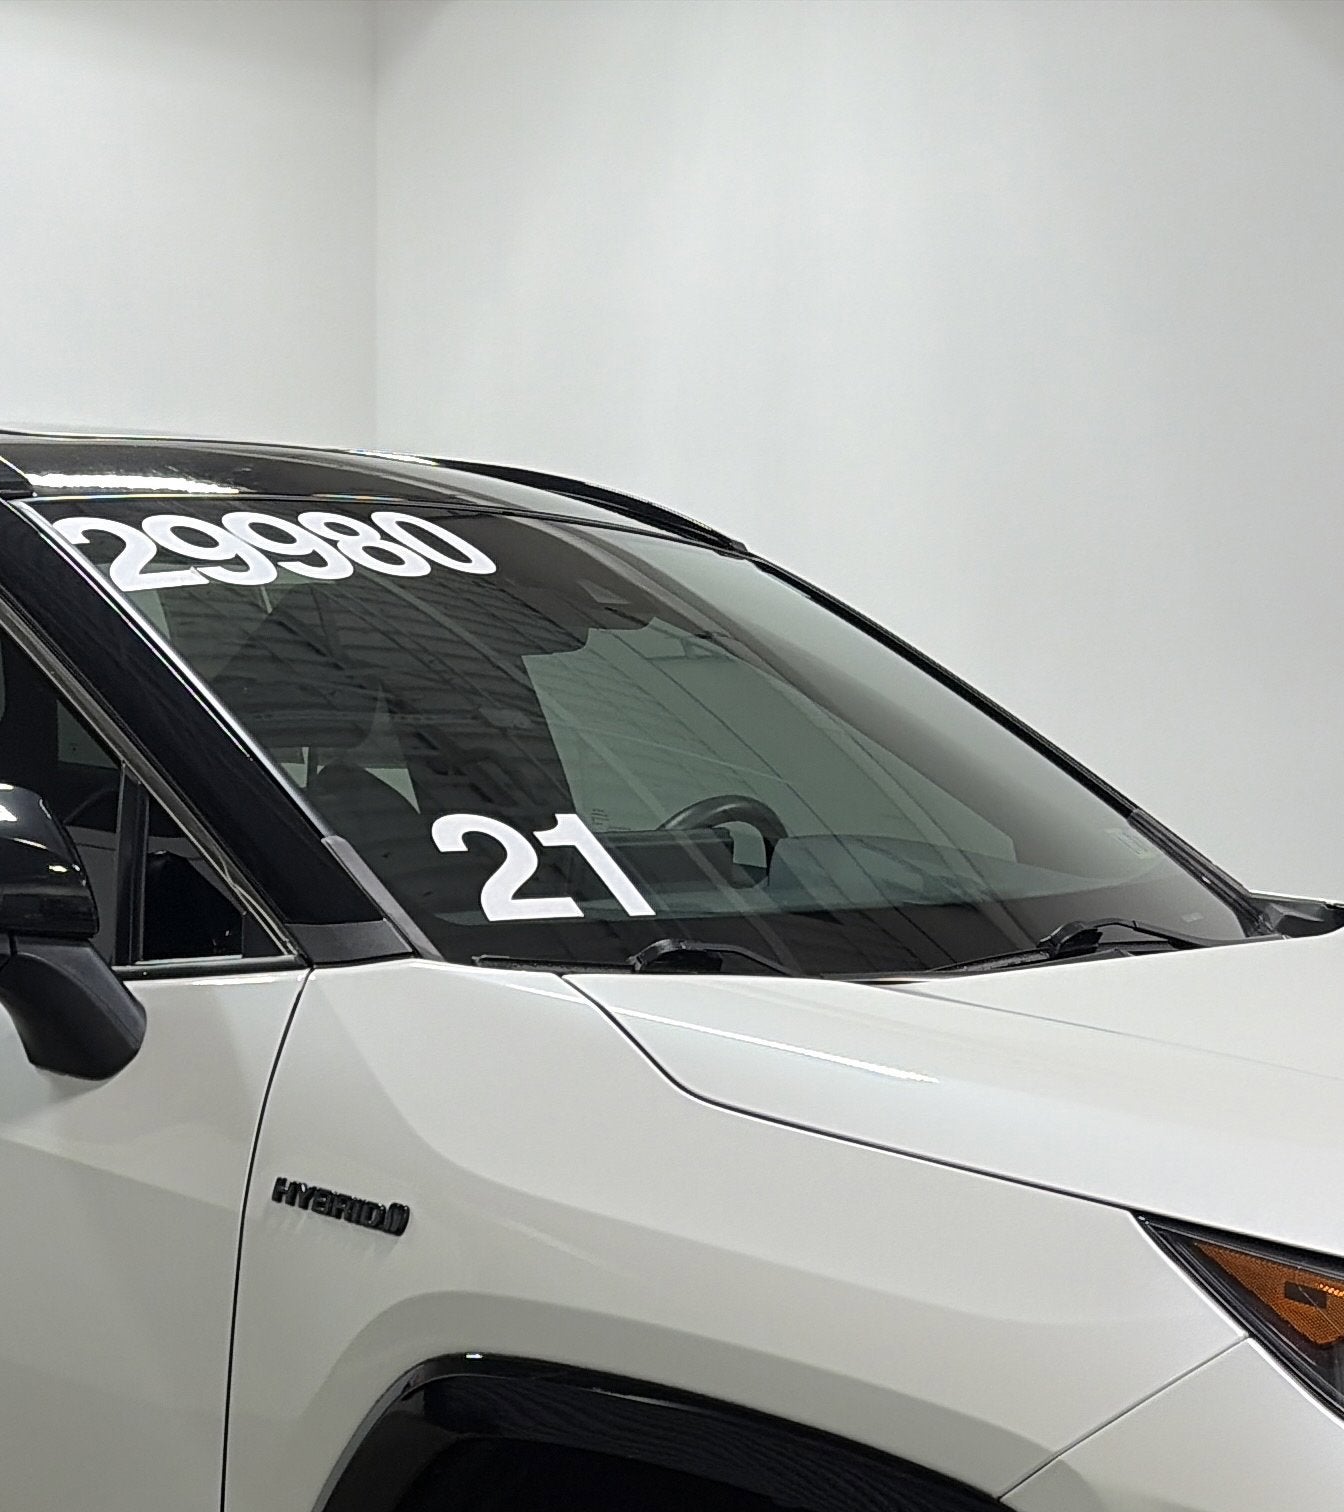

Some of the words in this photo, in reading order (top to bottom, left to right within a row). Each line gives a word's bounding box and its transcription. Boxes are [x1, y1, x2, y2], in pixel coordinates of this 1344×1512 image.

[53, 511, 497, 592] 29980
[431, 813, 656, 922] 21
[271, 1177, 387, 1228] HYBRID
